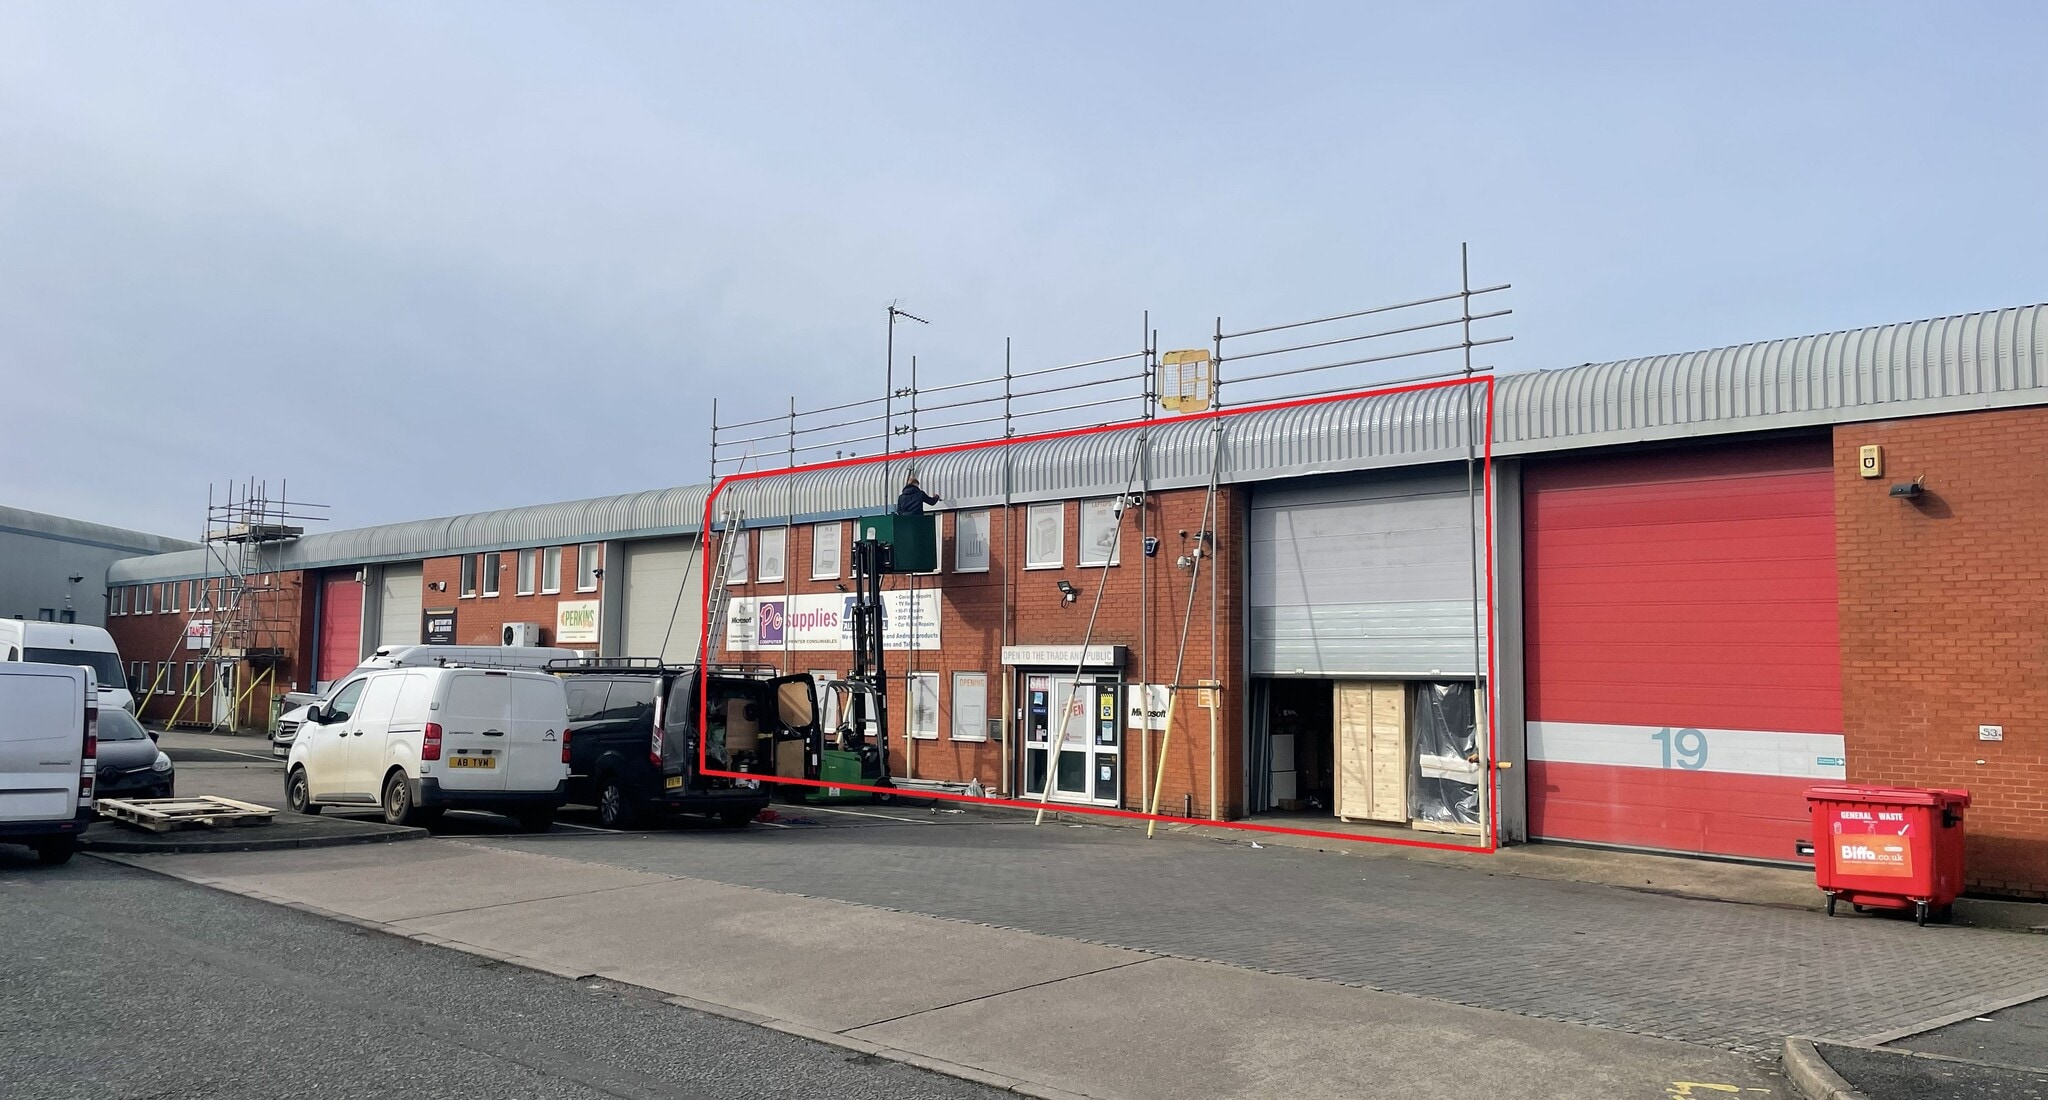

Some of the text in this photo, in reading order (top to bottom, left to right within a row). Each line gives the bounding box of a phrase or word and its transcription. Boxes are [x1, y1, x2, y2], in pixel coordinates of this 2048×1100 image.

[565, 610, 594, 627] PERKINS
[787, 608, 838, 631] supplies
[916, 632, 938, 640] products
[1003, 651, 1020, 661] OPEN
[1022, 651, 1031, 661] TO
[1032, 651, 1045, 660] THE
[1046, 651, 1068, 660] TRADE
[1087, 650, 1112, 661] PUBLIC
[960, 679, 985, 687] OPENING
[1063, 704, 1084, 717] OEN
[1131, 708, 1166, 718] Micosoft
[1652, 727, 1708, 770] 19
[1841, 811, 1904, 821] GENERAL WASTE
